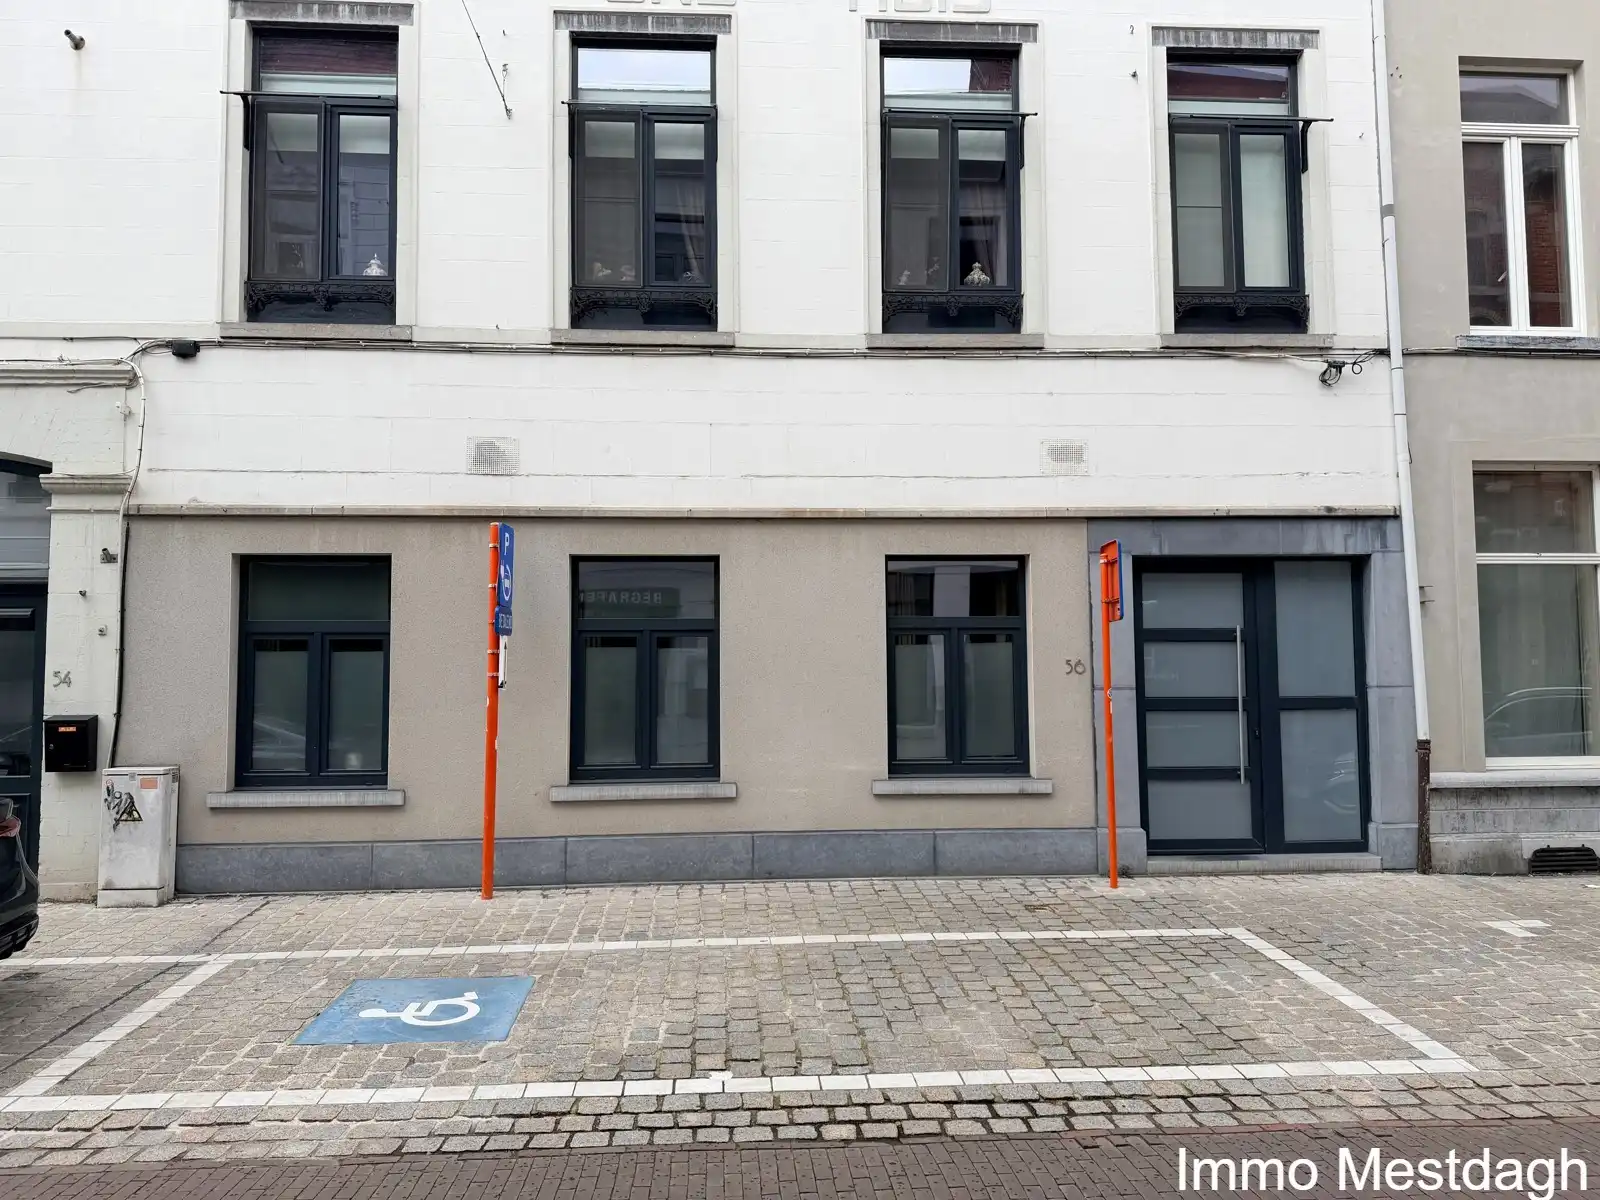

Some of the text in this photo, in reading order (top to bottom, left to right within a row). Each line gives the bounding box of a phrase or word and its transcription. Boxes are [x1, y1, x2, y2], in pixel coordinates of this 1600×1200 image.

[504, 532, 510, 556] P
[1065, 659, 1086, 675] 56
[52, 670, 72, 688] 54
